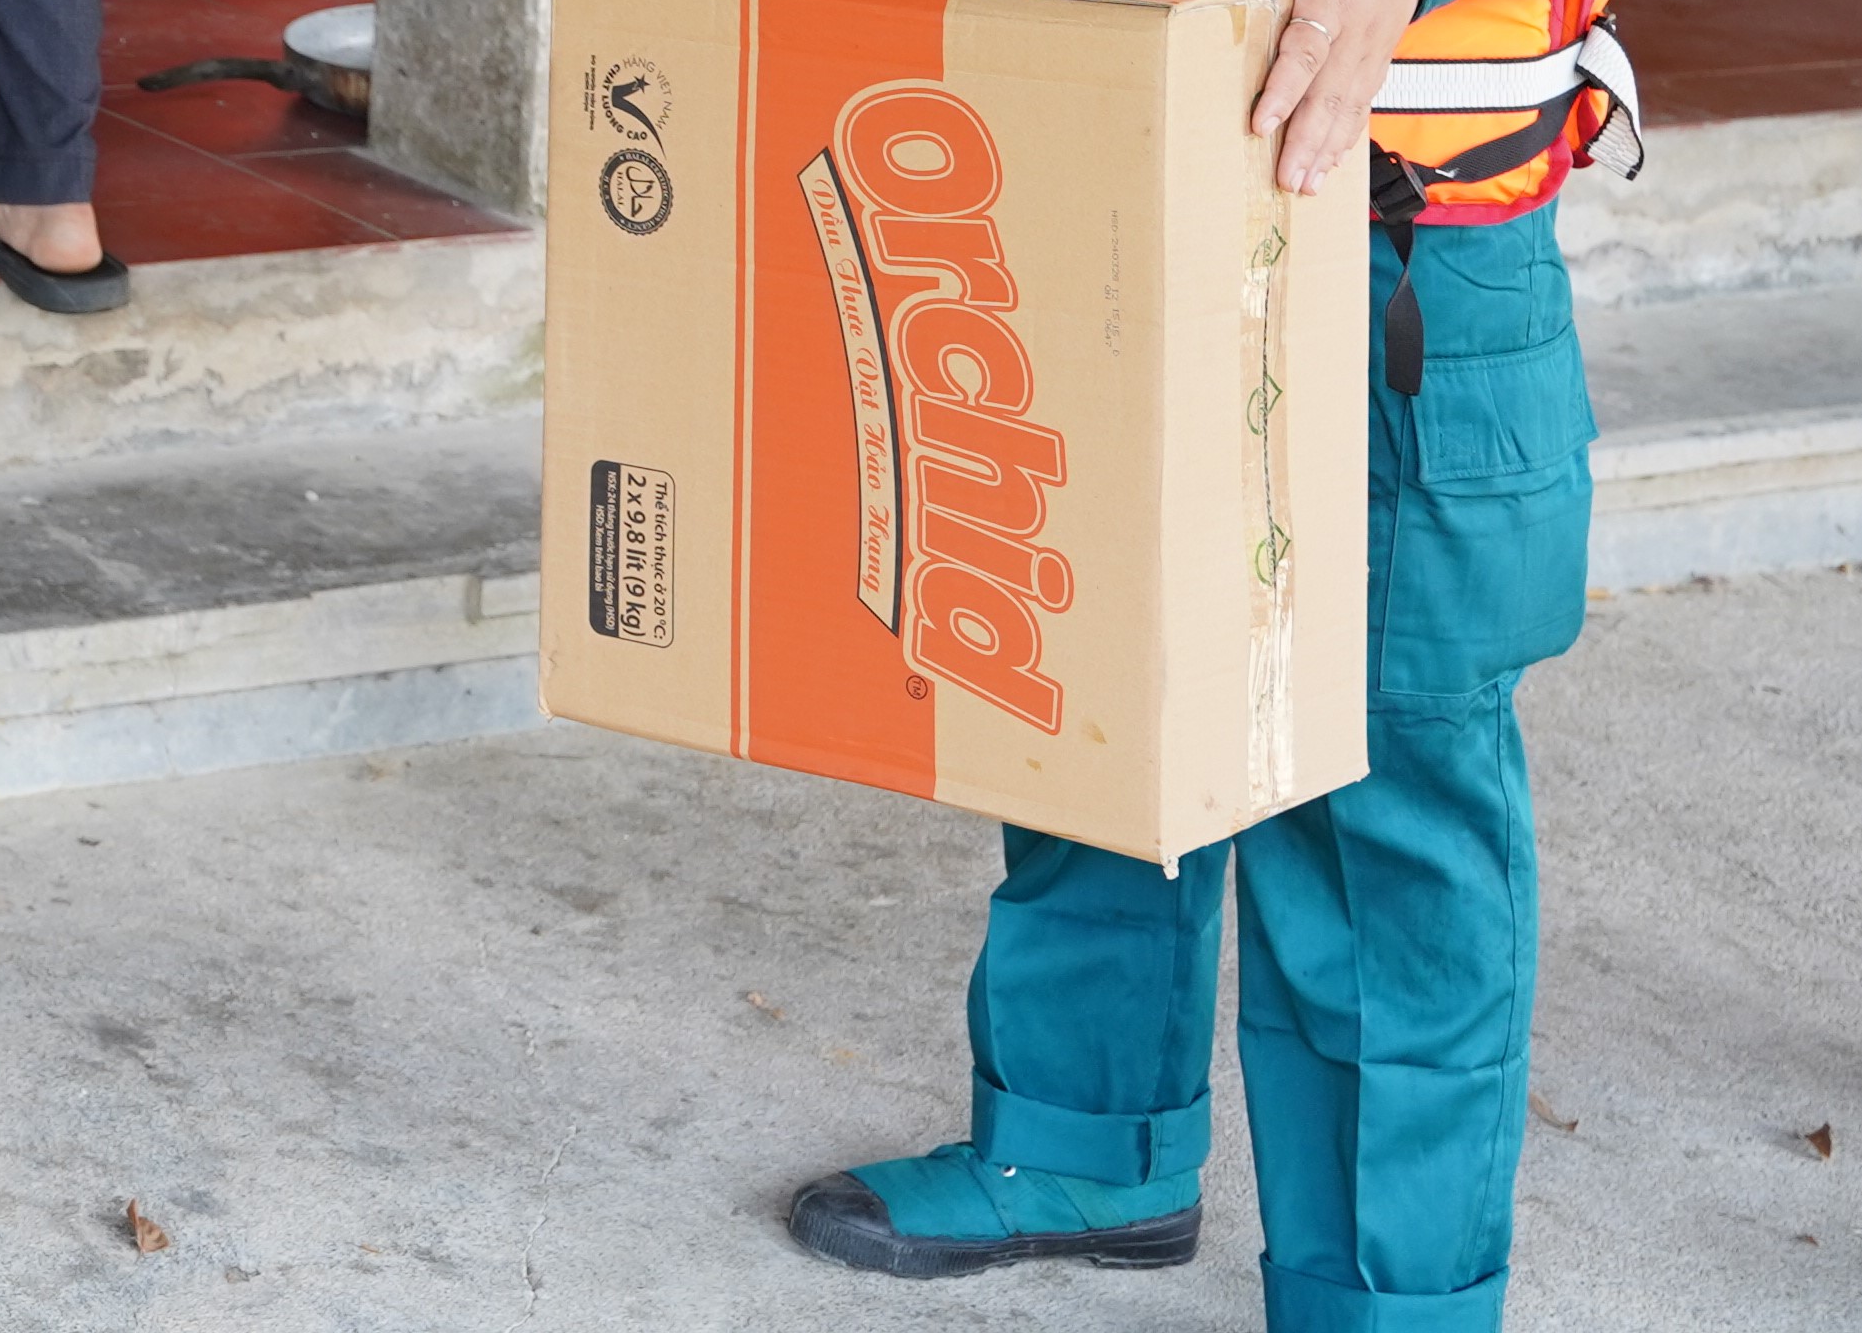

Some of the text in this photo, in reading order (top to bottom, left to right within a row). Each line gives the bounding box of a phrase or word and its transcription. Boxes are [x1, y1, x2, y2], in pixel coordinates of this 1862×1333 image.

[615, 171, 623, 208] HALAL
[811, 178, 890, 594] Dầu Thực Vật Hảo Hạng
[835, 78, 1075, 735] orchid
[607, 492, 615, 503] 24
[654, 482, 668, 511] Thể
[654, 514, 668, 541] tích
[620, 473, 646, 636] 2 x 9,8 lít (9 kg)
[650, 546, 667, 579] thực
[653, 596, 665, 615] 20
